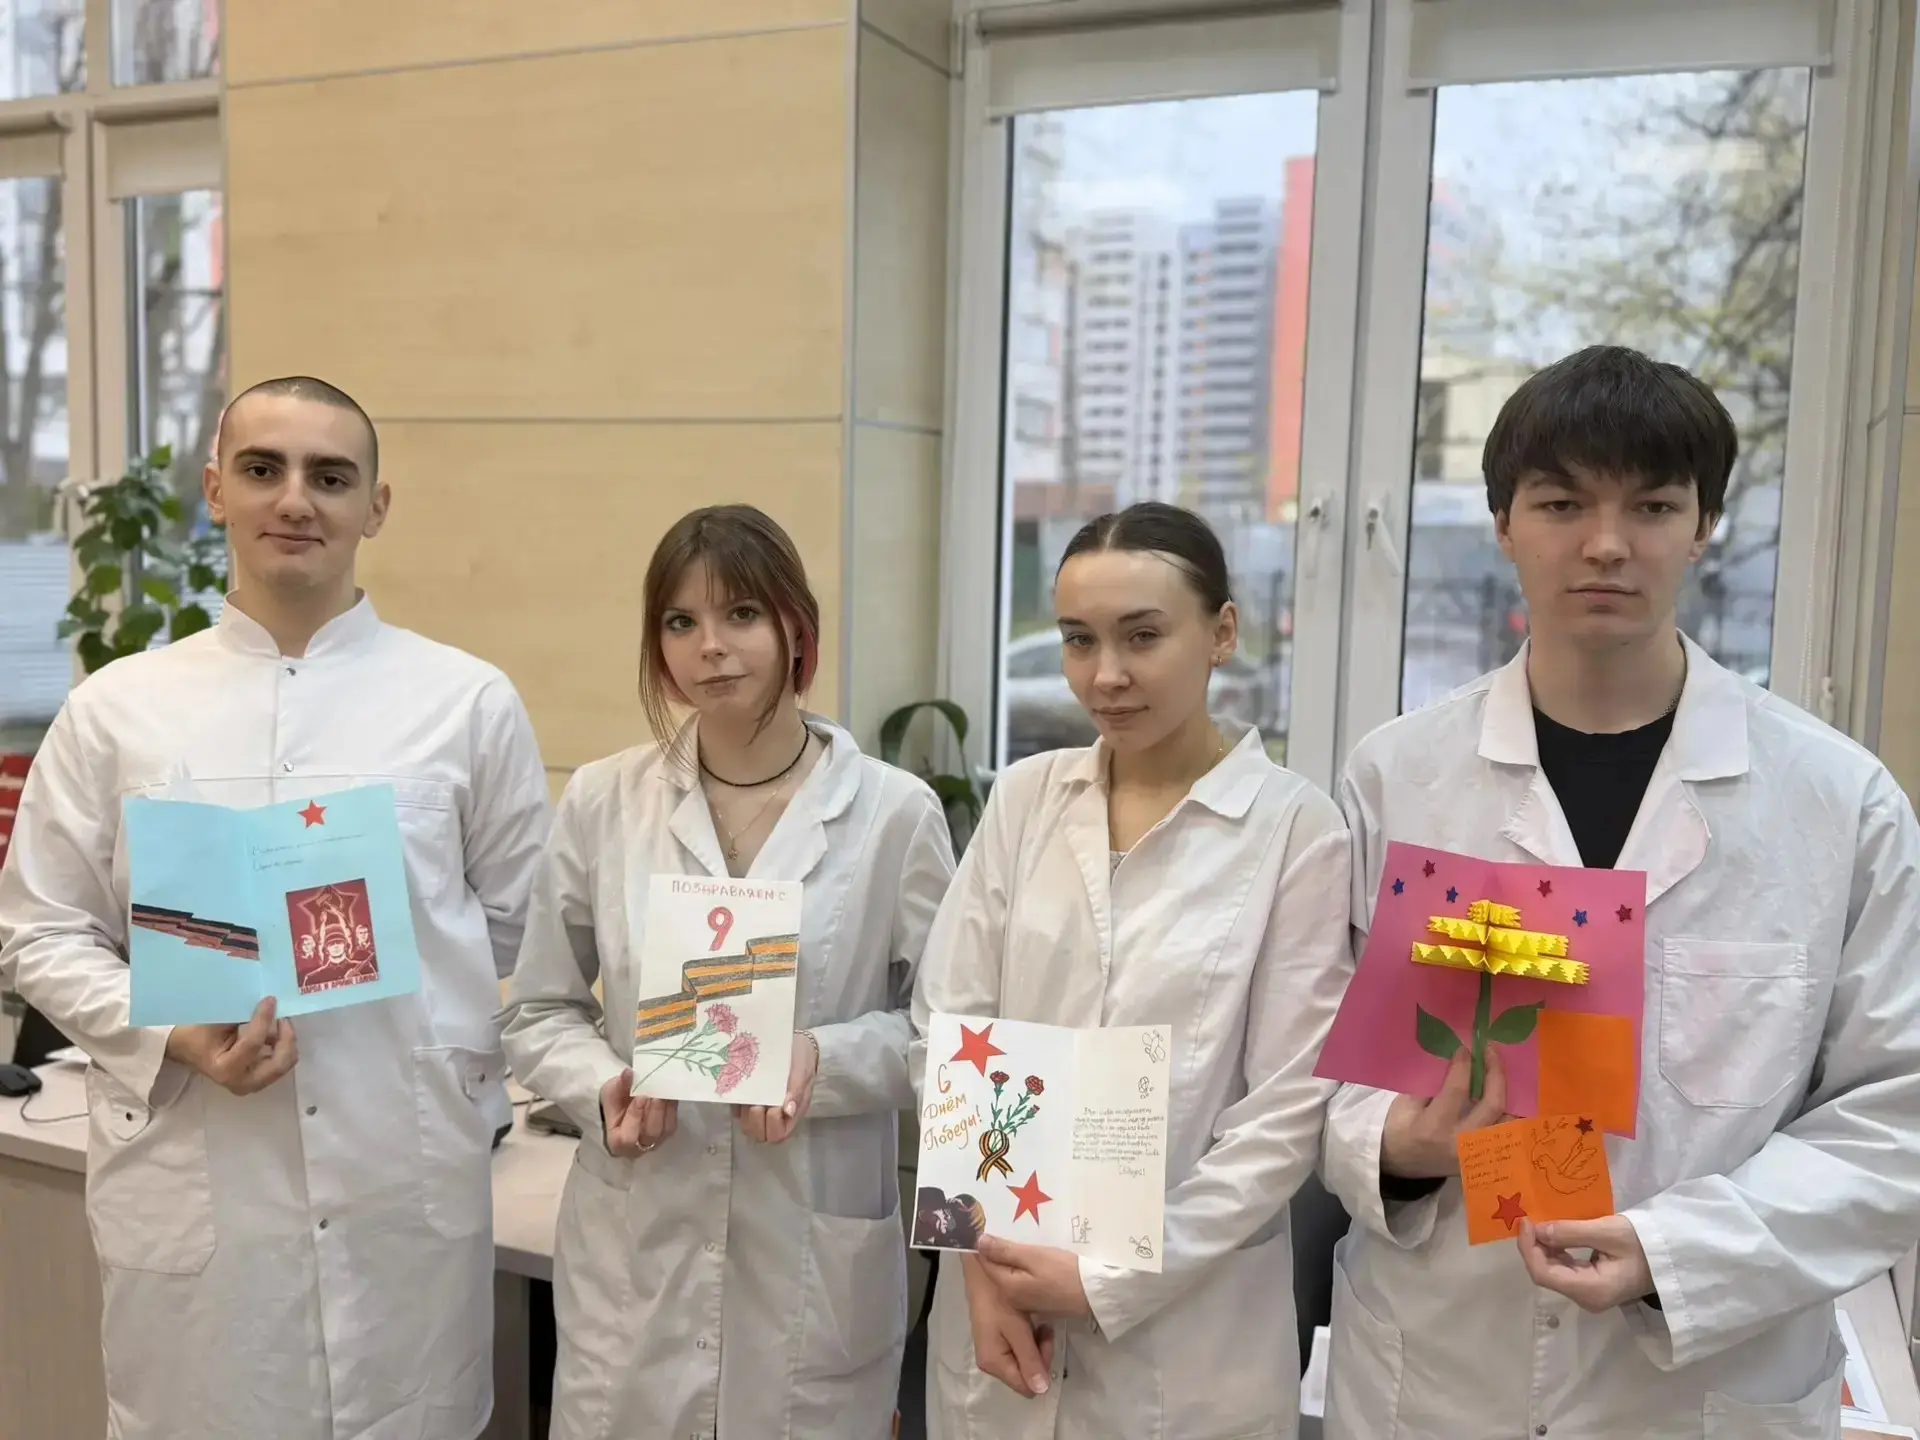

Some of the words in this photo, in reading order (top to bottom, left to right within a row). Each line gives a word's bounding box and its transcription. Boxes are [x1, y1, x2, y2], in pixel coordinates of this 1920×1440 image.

[672, 880, 775, 900] ПОЗДРАВЛЯЕМ
[707, 906, 734, 951] 9
[924, 1093, 967, 1119] Днём
[924, 1104, 983, 1150] Победы!
